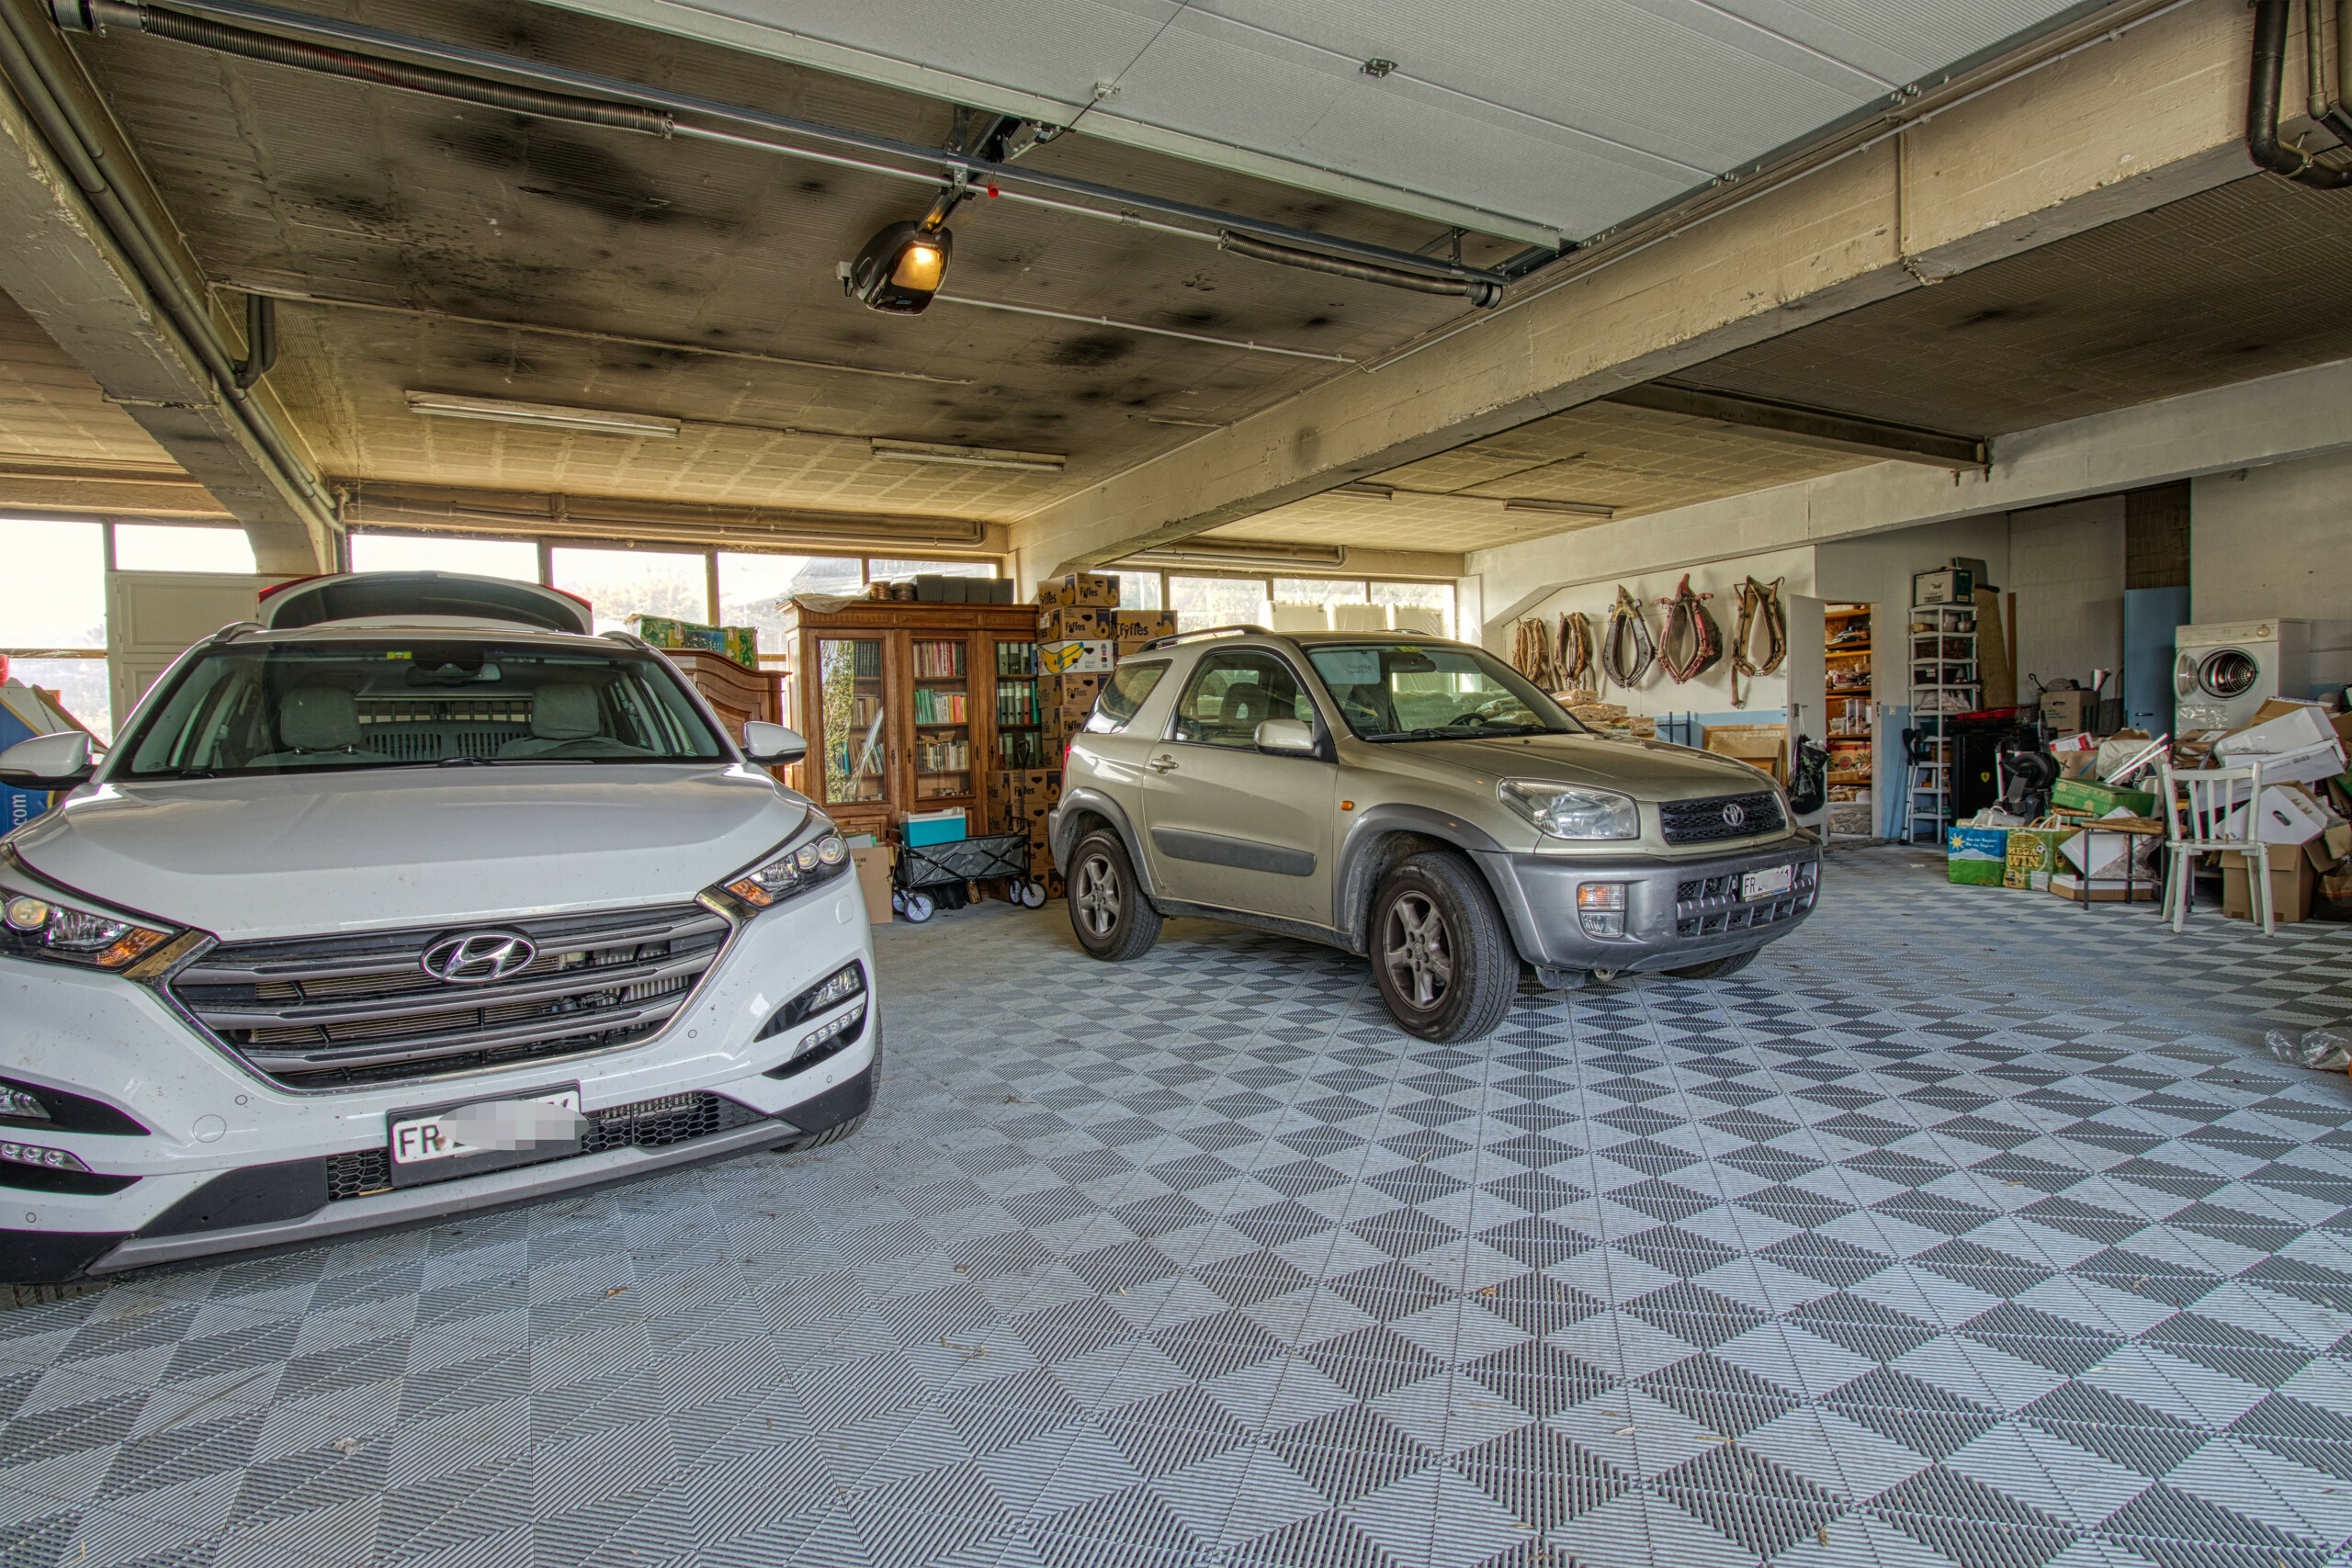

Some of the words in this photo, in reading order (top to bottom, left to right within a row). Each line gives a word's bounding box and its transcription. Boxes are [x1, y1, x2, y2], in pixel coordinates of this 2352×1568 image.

[1120, 622, 1148, 639] Fyffes
[12, 794, 28, 826] com
[2007, 846, 2039, 856] MEGA
[2007, 854, 2040, 868] WIN
